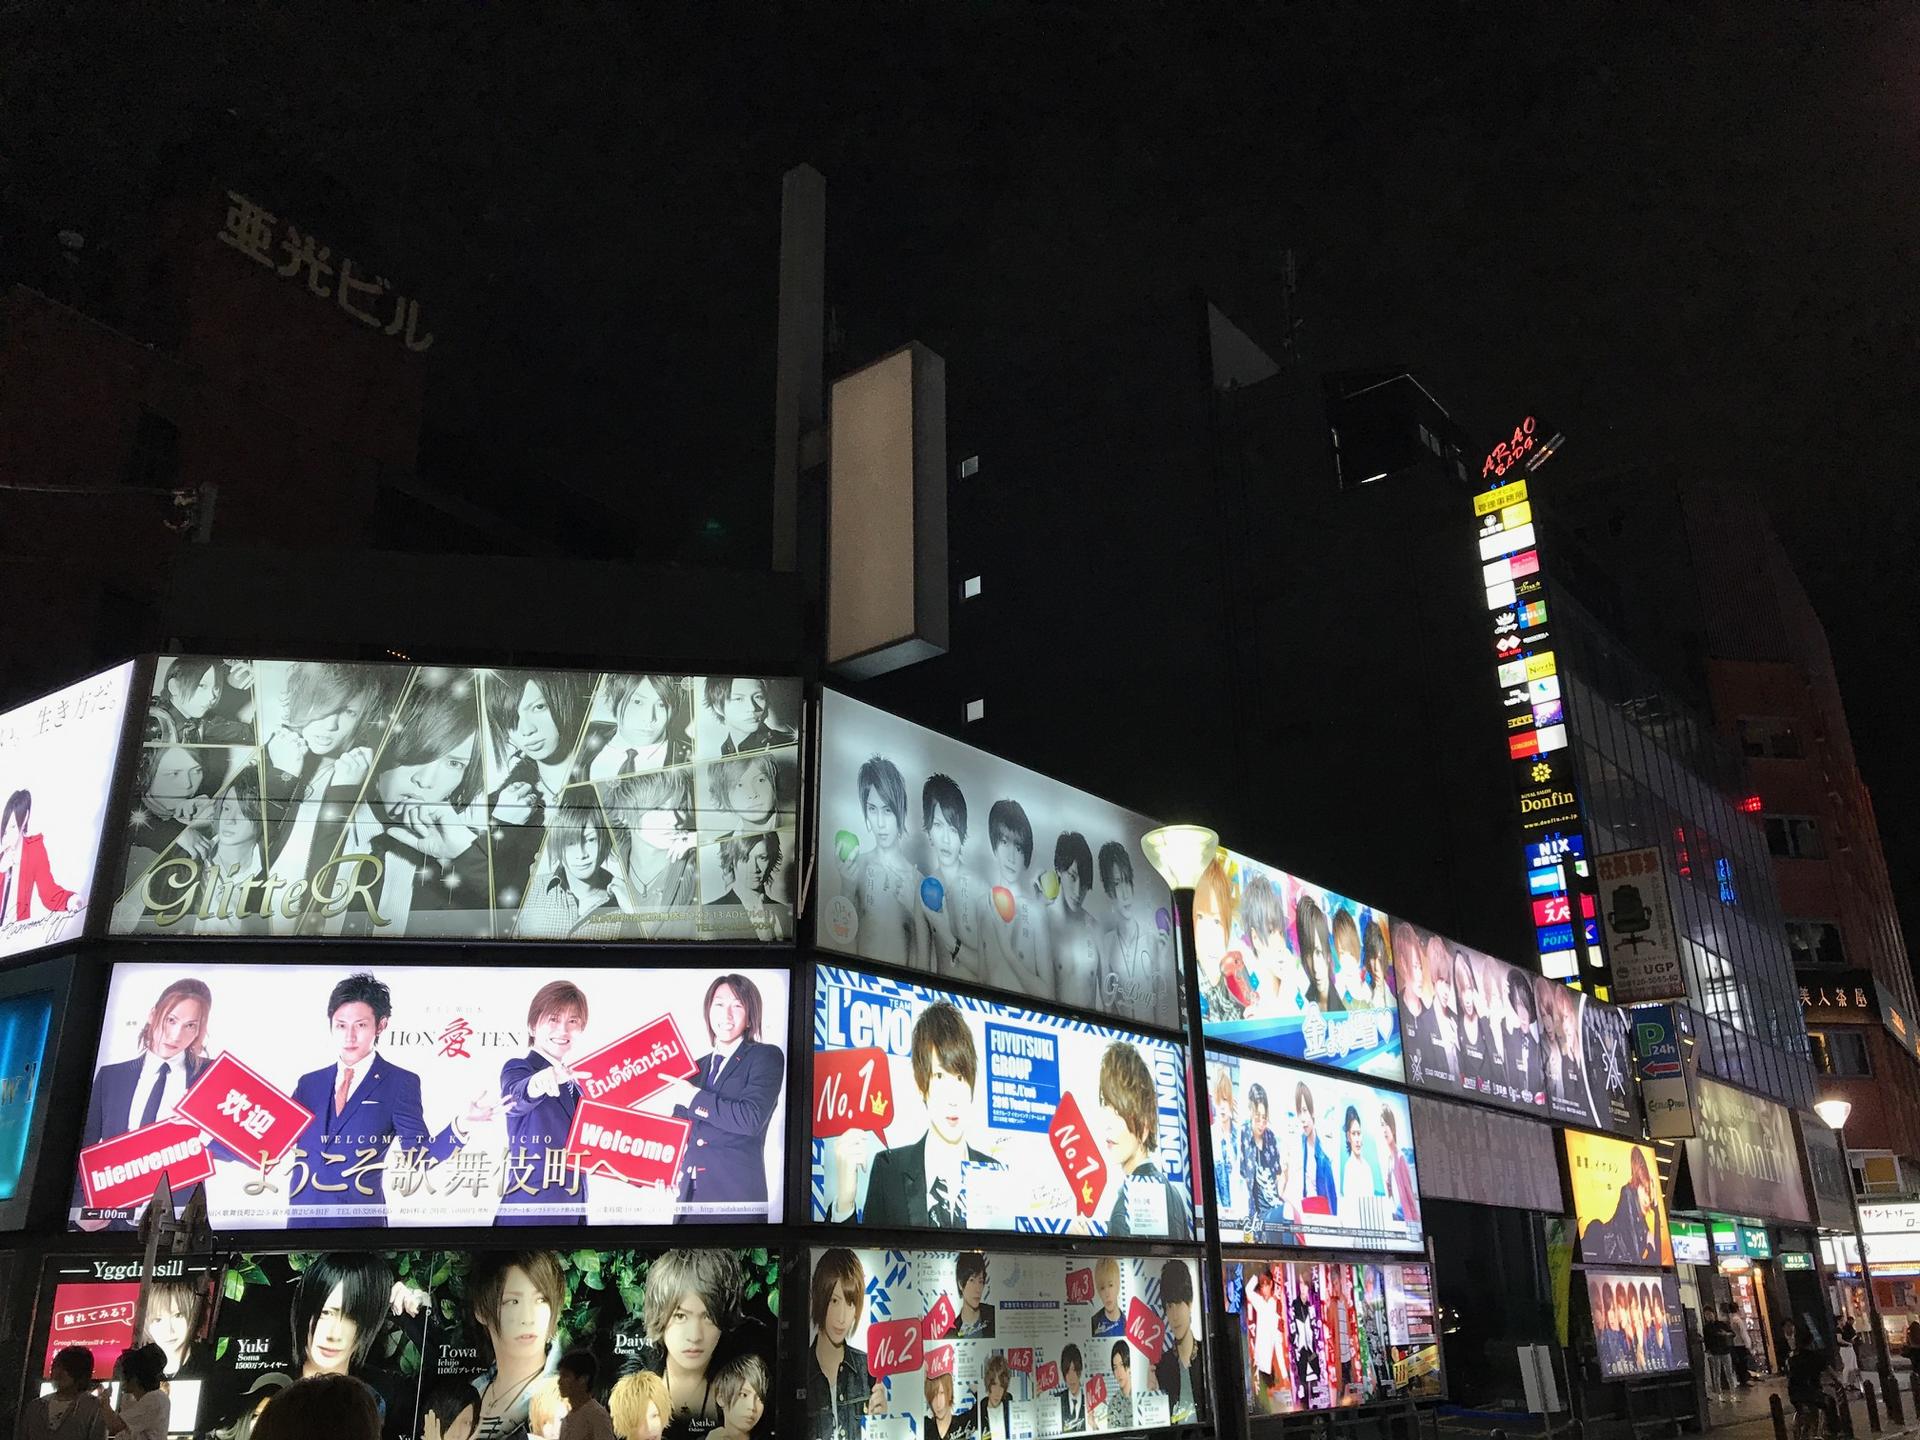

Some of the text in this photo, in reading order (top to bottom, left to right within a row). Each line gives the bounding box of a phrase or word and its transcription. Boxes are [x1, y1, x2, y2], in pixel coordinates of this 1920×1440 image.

[217, 189, 434, 352] 亜光ビル
[1483, 416, 1535, 478] ARAO
[1521, 791, 1574, 814] Donfin
[1539, 838, 1571, 857] NIX
[141, 853, 392, 928] GlitteR
[1643, 961, 1674, 976] UGP
[438, 1018, 475, 1059] 愛
[991, 1029, 1055, 1061] FUYUTSUKI
[1637, 1022, 1665, 1057] P
[1651, 1043, 1676, 1056] 24h
[992, 1054, 1032, 1081] GROUP
[817, 1058, 875, 1122] No.1
[216, 1088, 277, 1141] 欢迎
[320, 1134, 553, 1146] WELCOME TO KICHO
[580, 1122, 676, 1164] Welcome
[1055, 1124, 1100, 1181] No.1
[91, 1134, 203, 1193] bienvenue
[243, 1146, 630, 1198] ようこそ歌舞伎町へ
[98, 1209, 128, 1220] 100m
[1786, 1256, 1804, 1264] NIX
[1071, 1274, 1091, 1301] No.3
[929, 1301, 951, 1341] No.3
[1130, 1315, 1156, 1350] No.2
[237, 1338, 269, 1352] Yuki
[439, 1344, 477, 1359] Towa
[615, 1333, 653, 1349] Daiya
[874, 1327, 916, 1368] No.2
[237, 1353, 260, 1362] Soma
[930, 1348, 951, 1373] No.4
[1010, 1350, 1031, 1367] No.5
[689, 1416, 716, 1428] Asuka
